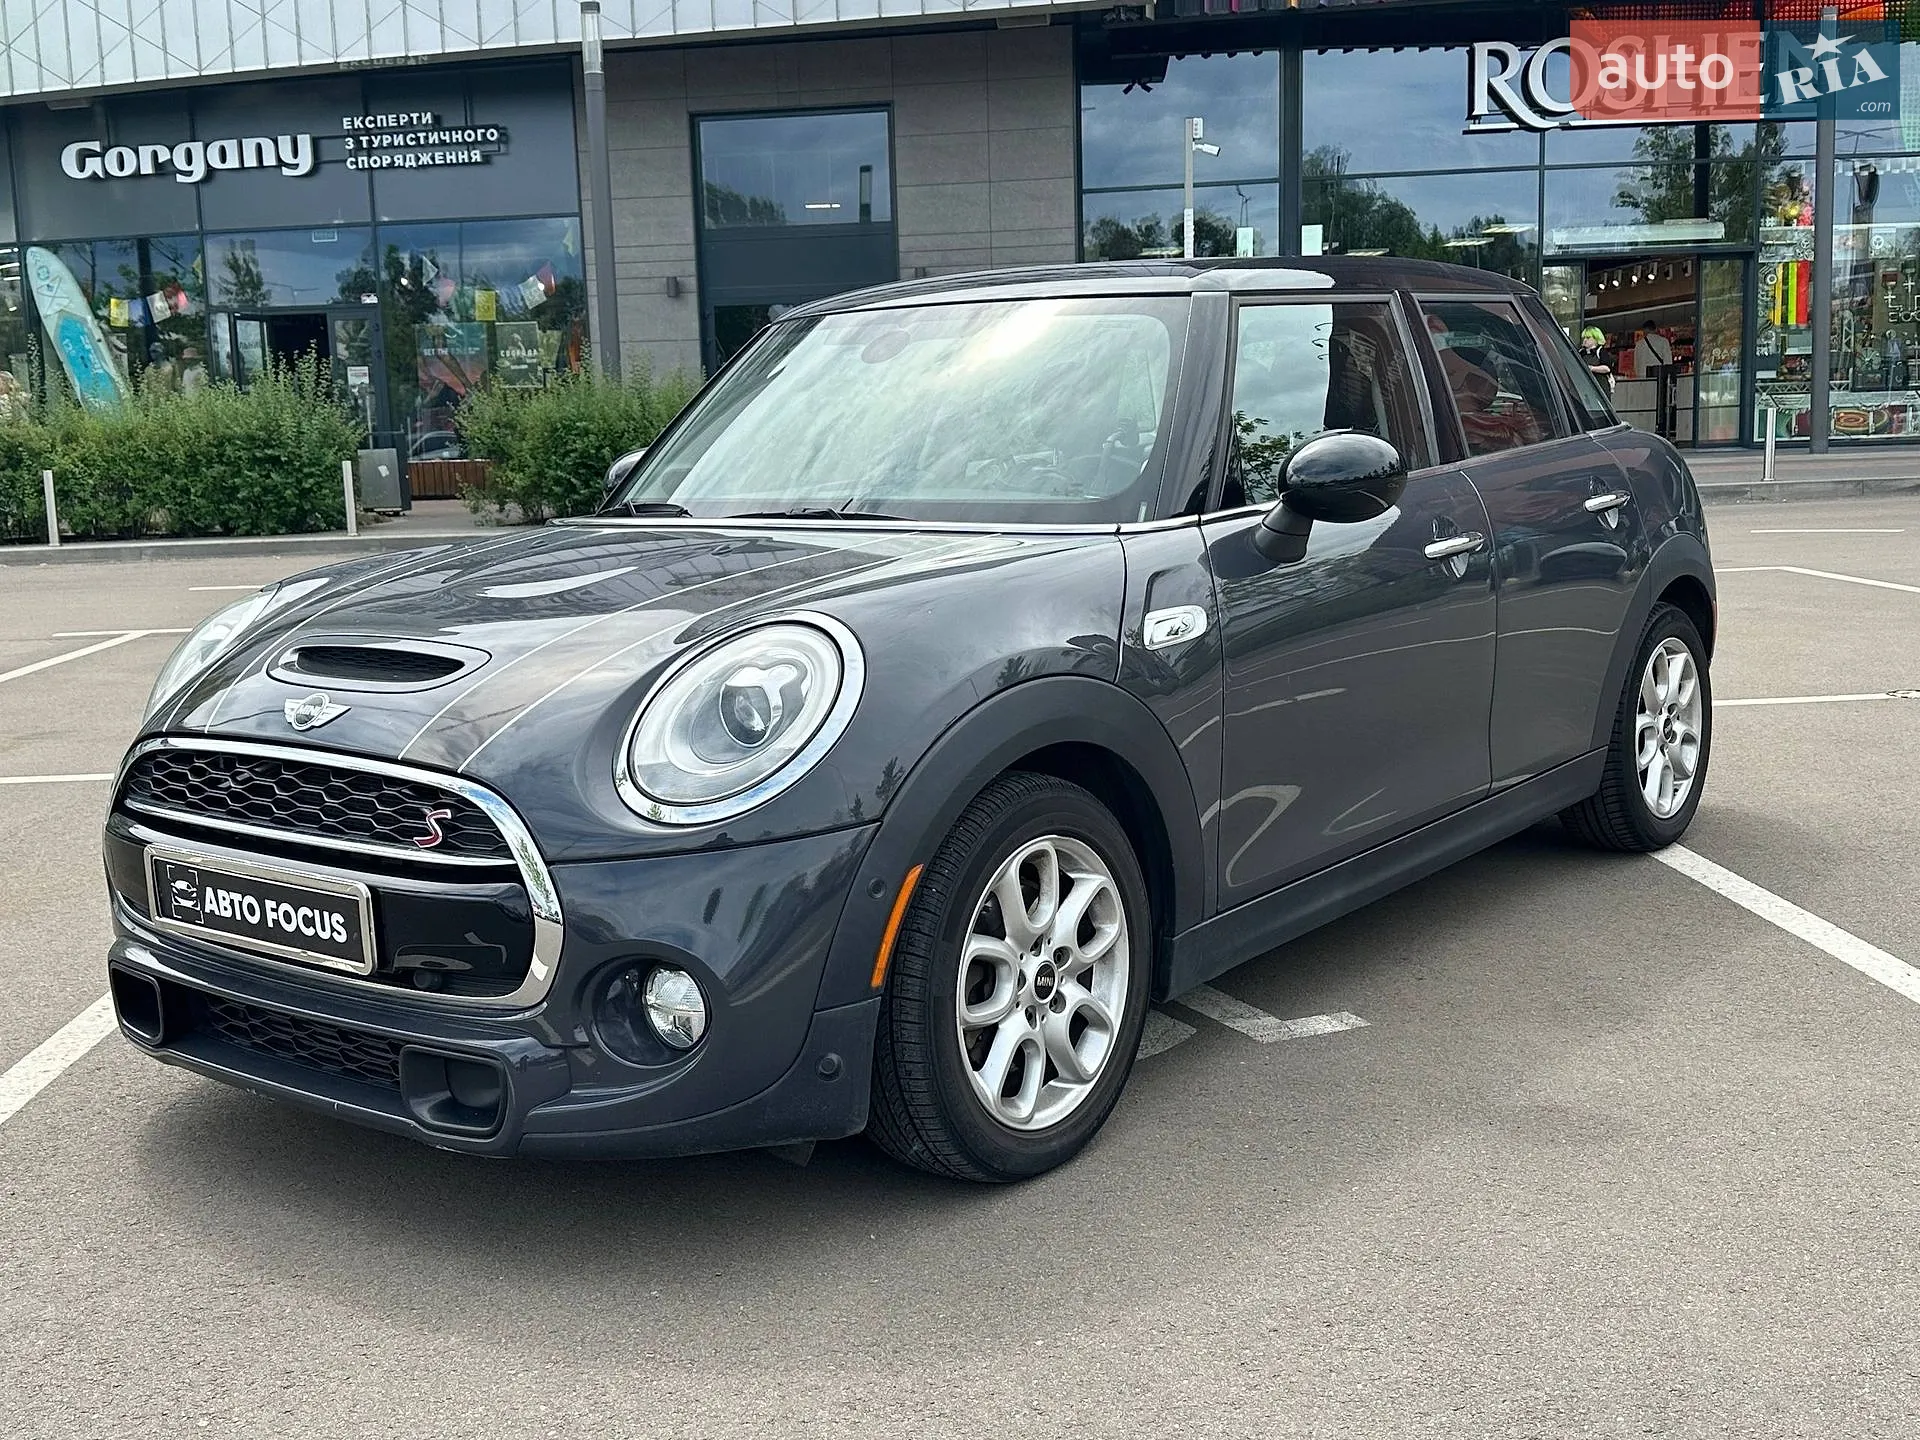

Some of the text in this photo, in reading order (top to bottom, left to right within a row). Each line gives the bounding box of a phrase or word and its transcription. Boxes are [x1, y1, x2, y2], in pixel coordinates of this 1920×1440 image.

[342, 112, 433, 130] ЕКСПЕРТИ
[360, 128, 498, 149] ТУРИСТИЧНОГО
[61, 134, 314, 183] Gorgany
[346, 150, 482, 170] СПОРЯДЖЕННЯ
[413, 809, 452, 848] S
[204, 886, 348, 944] АВТО FOCUS
